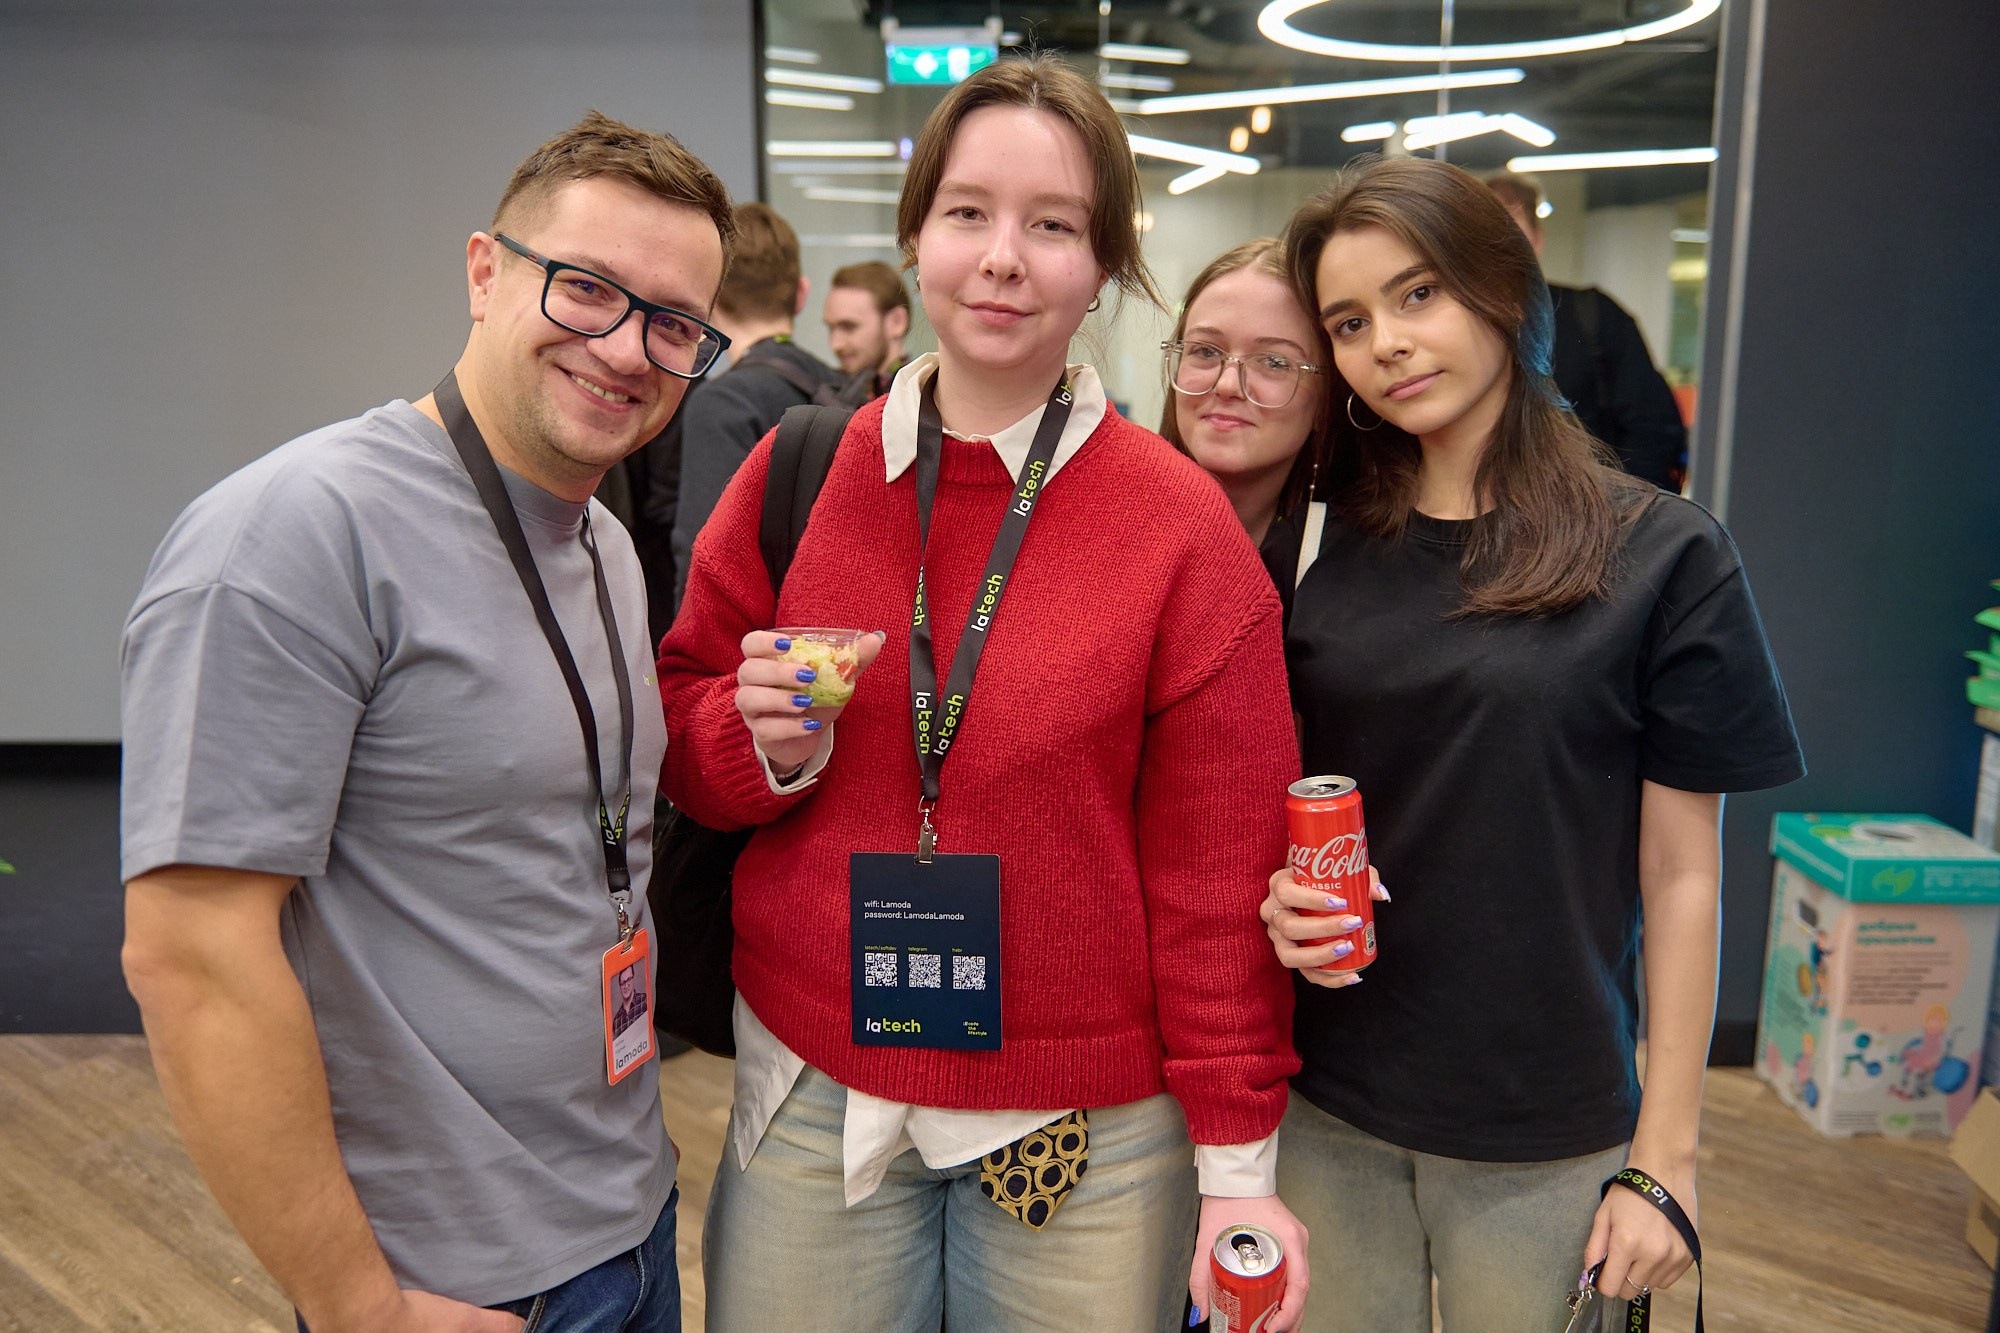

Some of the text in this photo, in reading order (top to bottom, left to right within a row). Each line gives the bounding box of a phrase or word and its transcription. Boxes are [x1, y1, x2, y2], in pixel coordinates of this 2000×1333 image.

[1013, 459, 1046, 517] latech
[970, 574, 1004, 632] latech
[933, 693, 964, 756] latech
[864, 900, 912, 909] wifi: Lamoda
[864, 911, 965, 921] password: LamodaLamoda
[865, 1018, 921, 1033] latech
[615, 1040, 648, 1070] lamoda
[1616, 1171, 1669, 1205] latech
